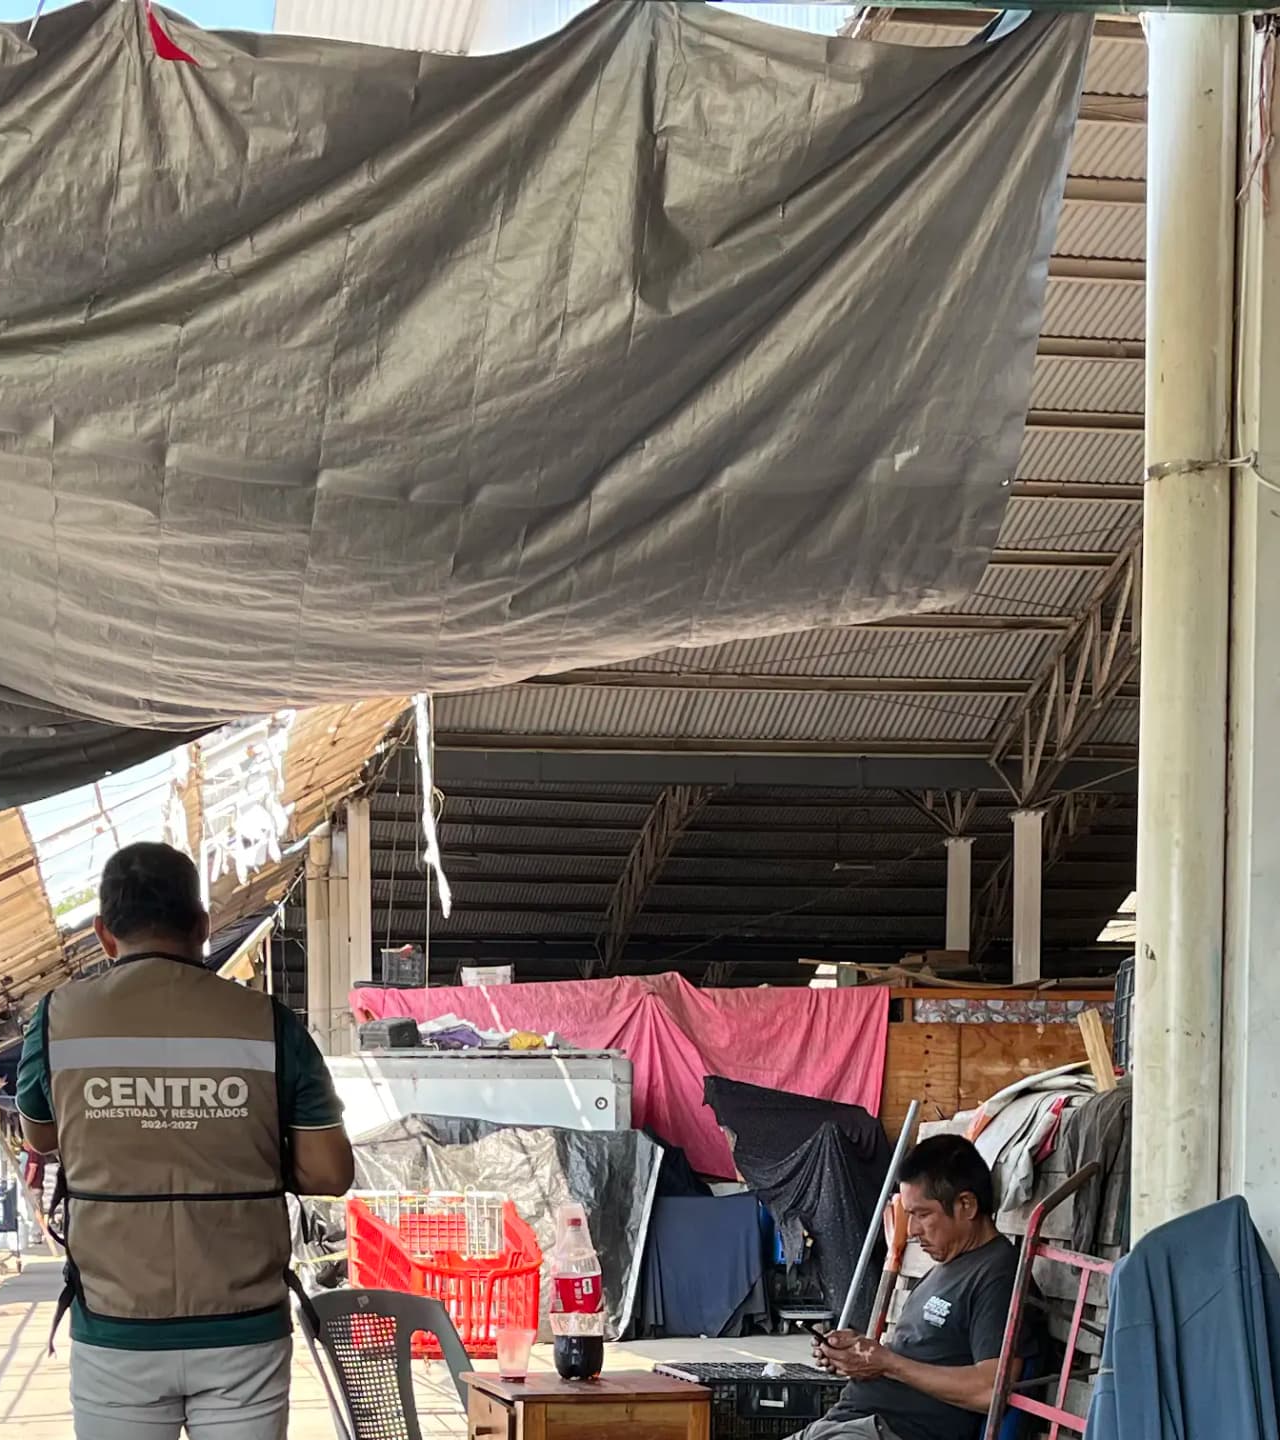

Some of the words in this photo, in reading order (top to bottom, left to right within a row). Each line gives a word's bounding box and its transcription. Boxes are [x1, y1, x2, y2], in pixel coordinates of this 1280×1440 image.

[83, 1076, 249, 1108] CENTRO
[85, 1107, 157, 1119] HONESTIDAD
[160, 1108, 168, 1118] Y
[171, 1107, 248, 1119] RESULTADOS
[140, 1119, 199, 1130] 2024-2027
